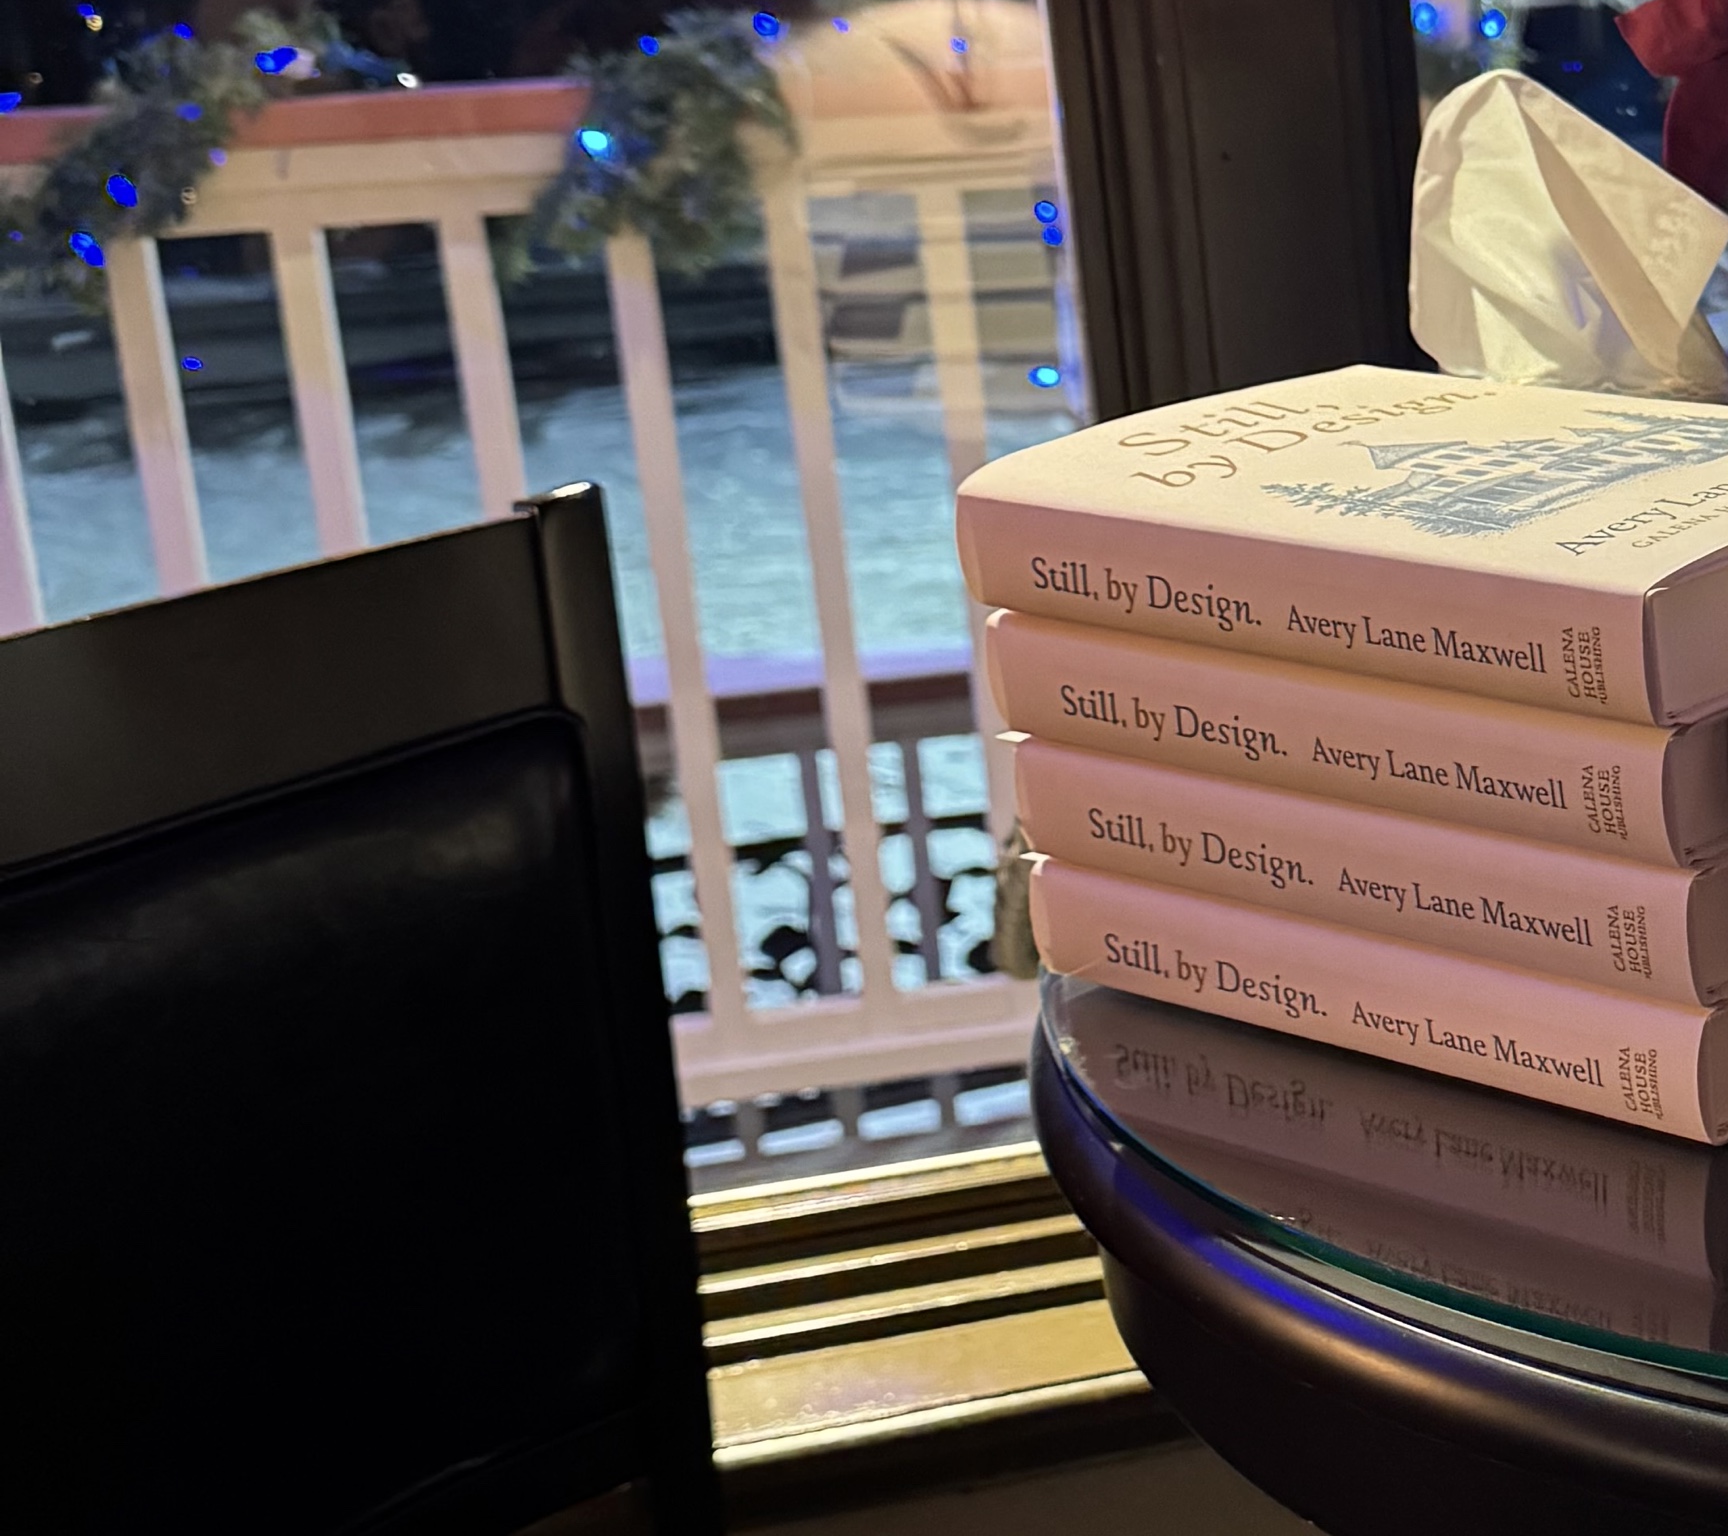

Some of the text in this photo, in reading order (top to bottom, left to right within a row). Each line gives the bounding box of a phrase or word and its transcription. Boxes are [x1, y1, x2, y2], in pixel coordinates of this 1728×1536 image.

[1118, 400, 1340, 457] Still,
[1130, 387, 1498, 490] by Design.
[1555, 506, 1677, 557] Avery
[1632, 513, 1718, 549] GALENA
[1031, 557, 1547, 673] Still, by Design. Avery Lane Maxwell
[1579, 631, 1597, 699] HOUSE
[1060, 684, 1568, 809] Still, by Design. Avery Lane Maxwell
[1598, 770, 1617, 835] HOUSE
[1088, 807, 1593, 947] Still, by Design. Avery Lane Maxwell
[1622, 910, 1642, 973] HOUSE
[1104, 933, 1604, 1087] Still, by Design. Avery Lane Maxwell
[1633, 1053, 1653, 1113] HOUSE
